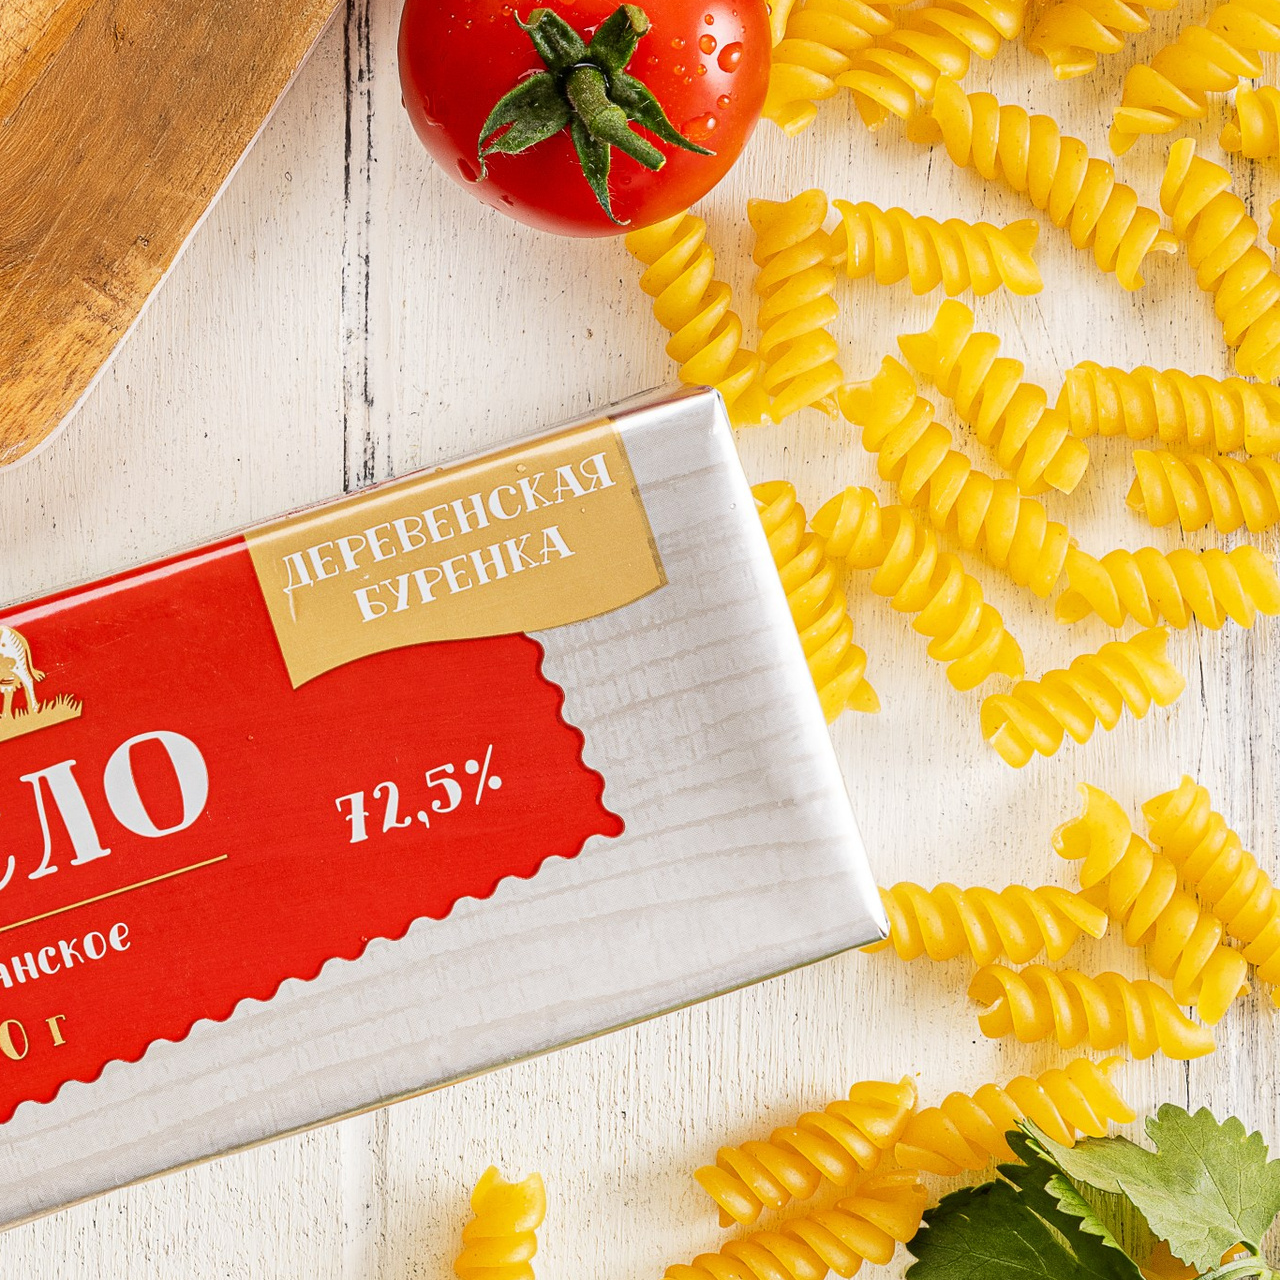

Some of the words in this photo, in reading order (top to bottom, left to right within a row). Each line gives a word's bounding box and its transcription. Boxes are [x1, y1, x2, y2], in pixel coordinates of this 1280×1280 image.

[282, 452, 616, 594] ДЕРЕВЕНСКАЯ
[352, 525, 576, 623] БУРЕНКА
[334, 744, 502, 844] 72,5%
[45, 1014, 67, 1047] г
